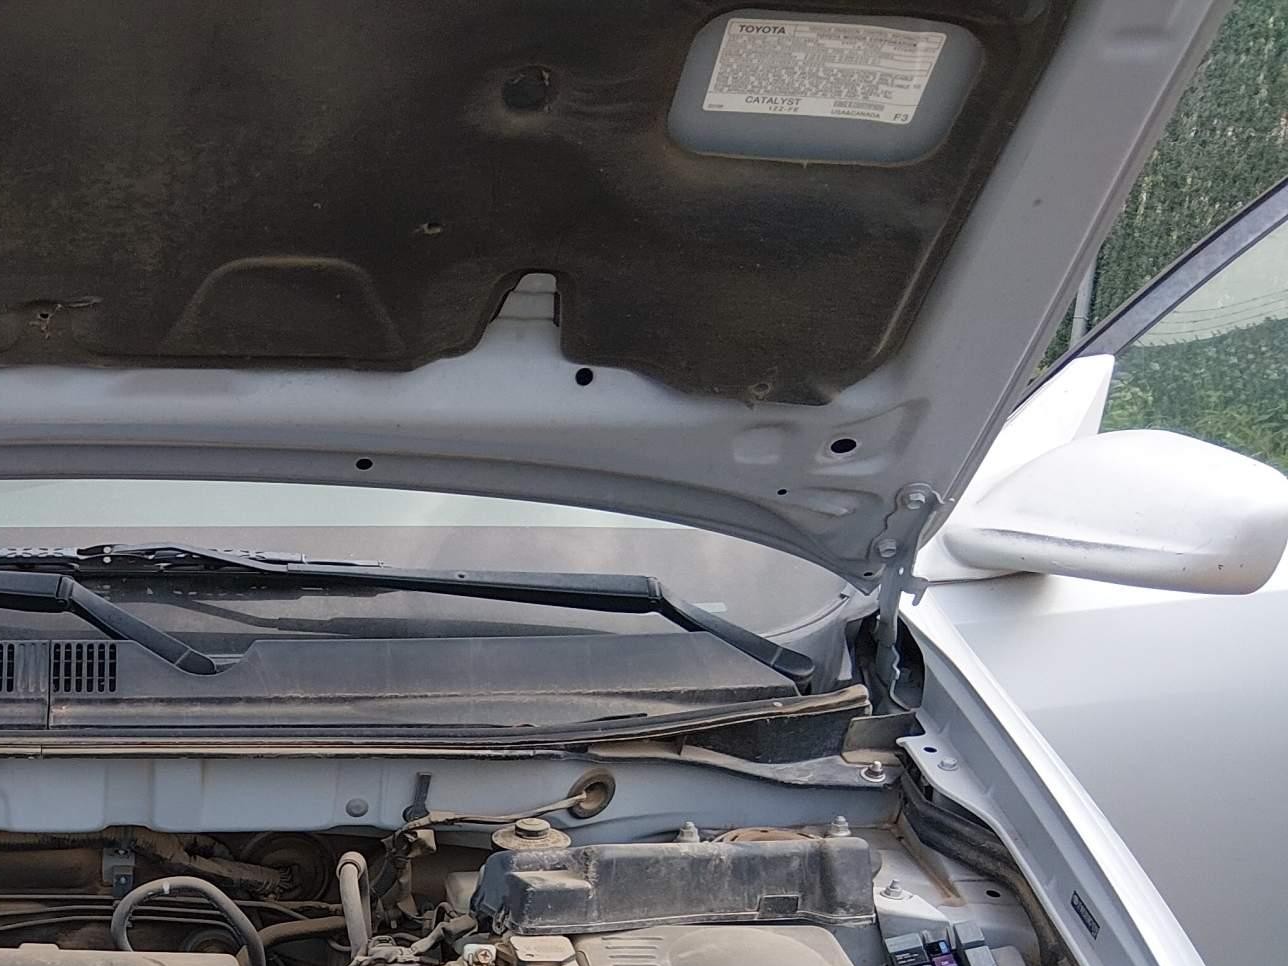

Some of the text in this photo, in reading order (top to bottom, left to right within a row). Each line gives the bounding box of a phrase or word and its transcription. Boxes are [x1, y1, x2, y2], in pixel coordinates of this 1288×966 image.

[738, 24, 786, 35] TOYOTA
[745, 95, 803, 106] CATALYST
[893, 113, 909, 122] F3
